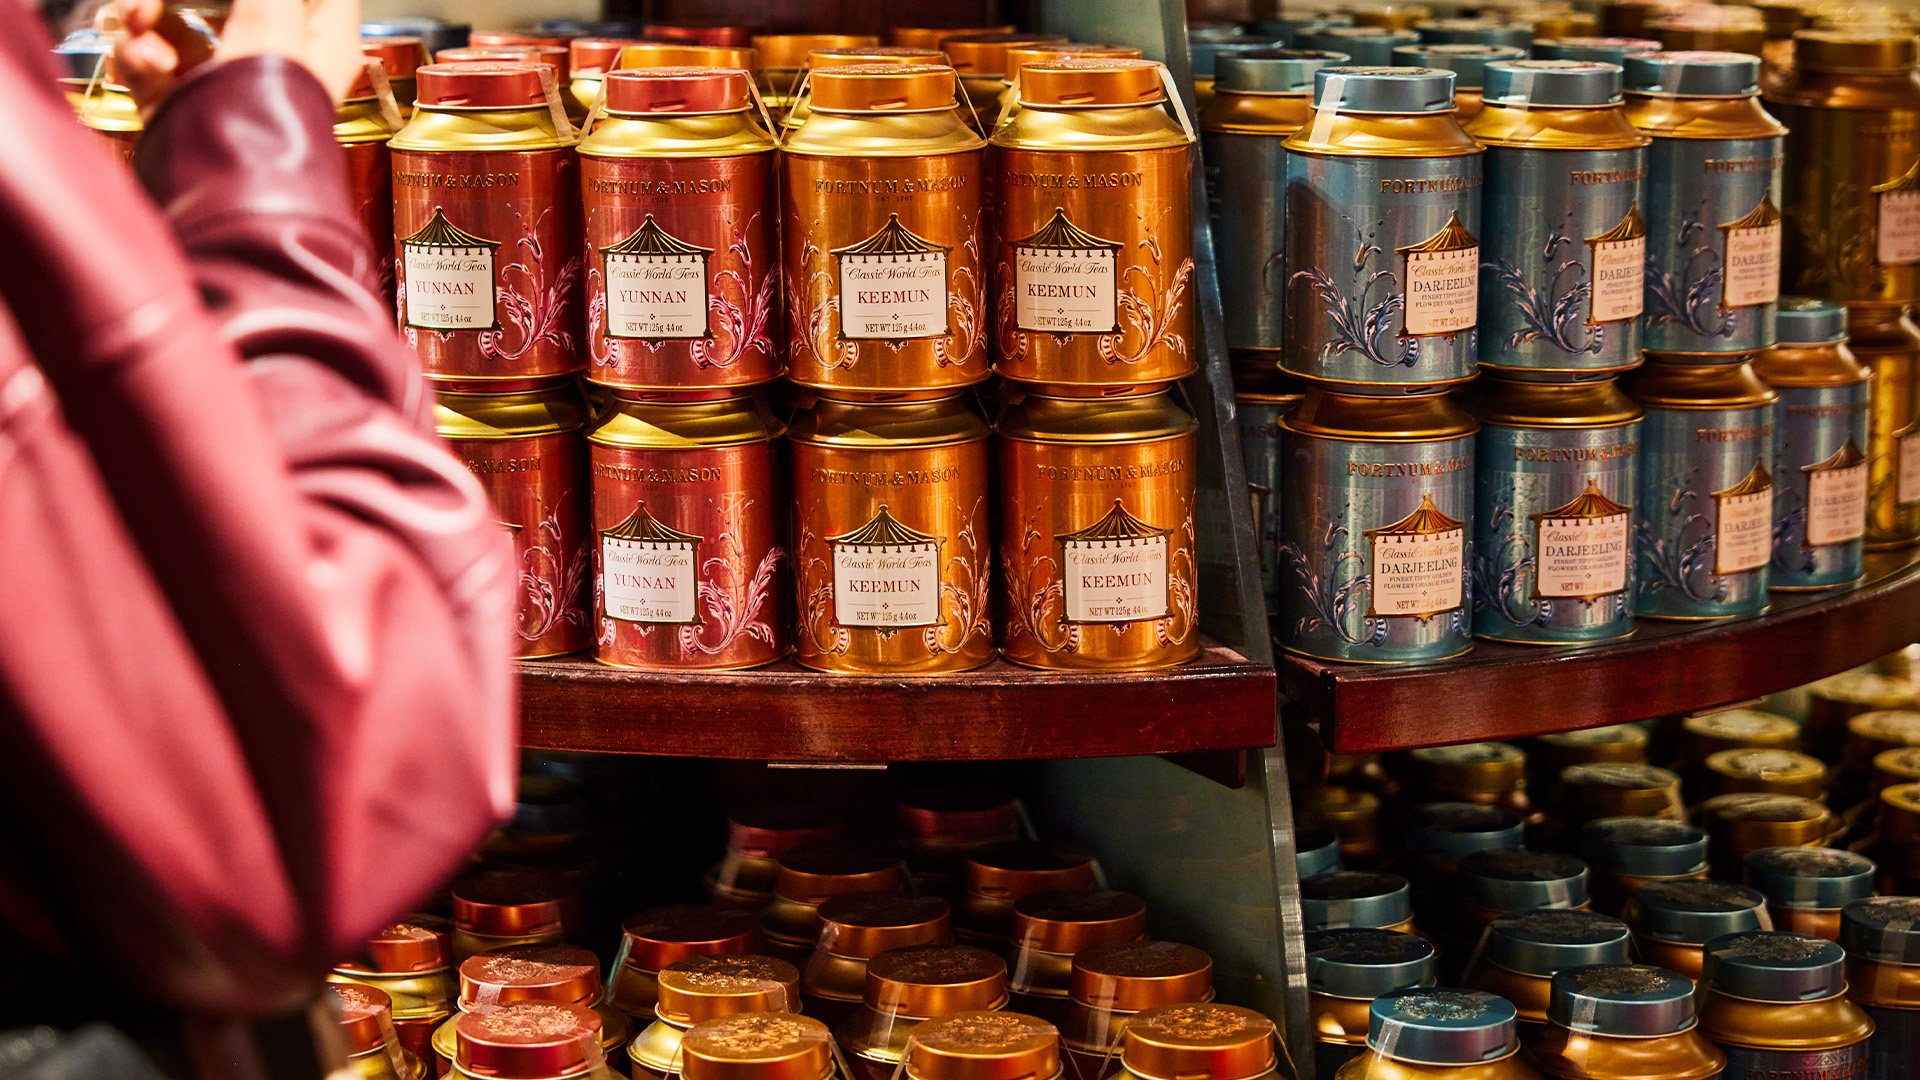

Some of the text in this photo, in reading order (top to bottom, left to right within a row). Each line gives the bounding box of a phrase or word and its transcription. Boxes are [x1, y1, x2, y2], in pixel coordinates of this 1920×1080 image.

[444, 175, 457, 188] &
[459, 173, 519, 188] MASON
[589, 178, 731, 194] FORTNUM & MASON
[815, 175, 966, 194] FORTNUM & MASON
[1067, 175, 1079, 188] &
[1083, 173, 1143, 189] MASON
[1381, 178, 1459, 193] FORTNUM
[408, 258, 487, 272] Classic World Teas
[1019, 259, 1108, 274] Classic World Teas
[1411, 264, 1444, 278] Classic
[609, 266, 700, 280] Classic World Teas
[845, 266, 941, 280] Classic World Teas
[416, 281, 474, 295] YUNNAN
[1028, 284, 1097, 298] KEEMUN
[620, 291, 687, 304] YUNNAN
[858, 289, 930, 304] KEEMUN
[626, 322, 638, 331] NET
[639, 323, 648, 332] WT
[865, 323, 879, 333] NET
[880, 323, 890, 333] WT
[1046, 316, 1057, 326] WT
[1514, 447, 1598, 462] FORTNUM
[1600, 447, 1610, 460] &
[483, 457, 541, 474] MASON
[593, 462, 721, 483] ORTNUM & MASON
[1037, 458, 1184, 481] FORTNUM & MASON
[1348, 462, 1432, 477] FORTNUM
[1434, 461, 1444, 475] &
[812, 467, 960, 486] FORTNUM & MASON
[1544, 529, 1581, 543] Classic
[1378, 546, 1417, 560] Classic
[1546, 541, 1622, 557] DARJEELING
[606, 550, 688, 566] Classic World Teas
[838, 555, 932, 570] Classic World Teas
[1069, 551, 1107, 565] Classic
[1107, 550, 1140, 564] World
[1381, 557, 1457, 574] DARJEELING
[614, 573, 675, 590] YUNNAN
[849, 579, 921, 593] KEEMUN
[1082, 572, 1153, 589] KEEMUN
[1415, 580, 1440, 588] ORANGE
[1560, 582, 1574, 591] NET
[1089, 607, 1104, 616] NET
[1104, 607, 1115, 616] WT
[1396, 600, 1410, 610] NET
[857, 611, 870, 621] NET
